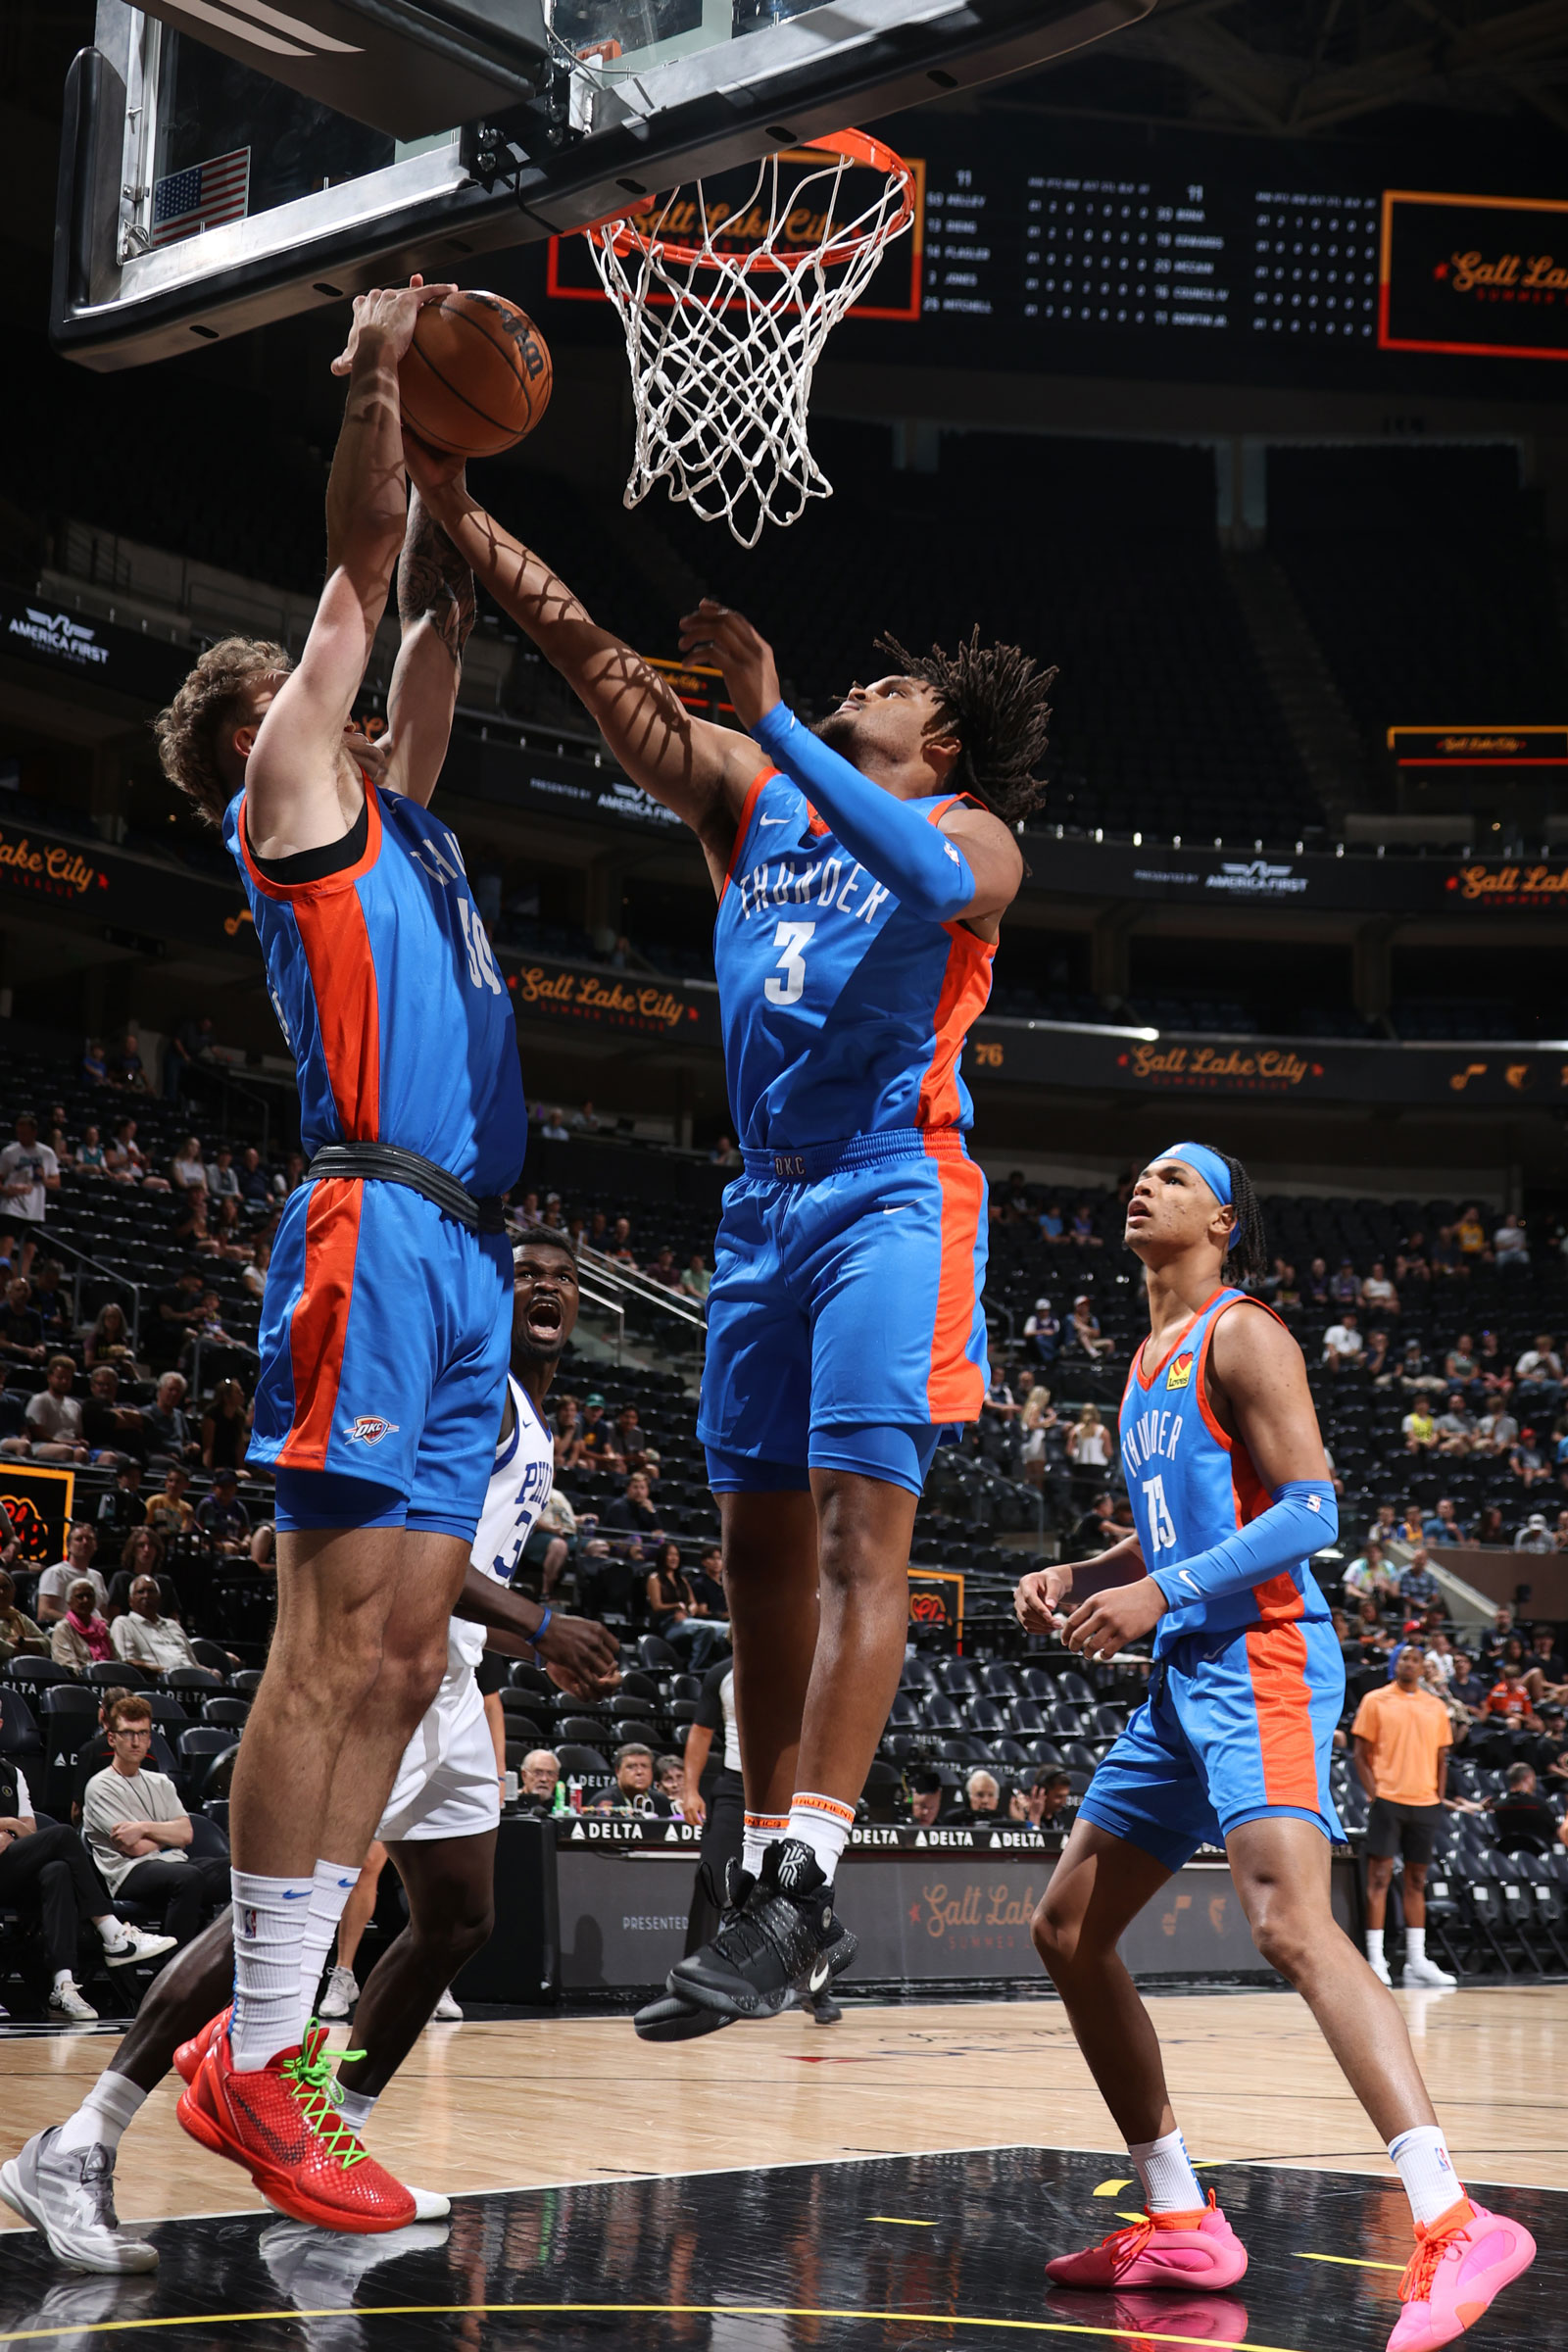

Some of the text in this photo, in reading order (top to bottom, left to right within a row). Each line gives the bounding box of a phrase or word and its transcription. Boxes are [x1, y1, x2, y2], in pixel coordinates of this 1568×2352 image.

[1450, 251, 1568, 292] Salt La
[9, 617, 70, 652] AMERICA
[70, 639, 109, 664] FIRST
[597, 793, 653, 817] AMERICA
[654, 807, 684, 824] FIRS
[44, 845, 94, 893] City
[1204, 874, 1309, 892] AMERICA FIRST
[1459, 864, 1520, 900] Salt
[740, 857, 890, 924] THUNDER
[764, 921, 816, 1005] 3
[520, 965, 684, 1027] Salt Lake City
[975, 1042, 1004, 1067] 76
[1131, 1044, 1309, 1084] Salt Lake City
[775, 1156, 806, 1176] OKC
[354, 1422, 382, 1438] OKC
[1121, 1409, 1184, 1478] THUNDER
[493, 1510, 535, 1580] 3
[2, 1681, 37, 1695] ELTA
[166, 1689, 208, 1703] DELTA
[588, 1823, 643, 1839] DELTA
[853, 1830, 899, 1844] DELTA
[929, 1831, 973, 1846] DELTA
[1003, 1833, 1045, 1847] DELTA
[622, 1916, 689, 1931] PRESENTED
[922, 1884, 1036, 1938] Salt Lak
